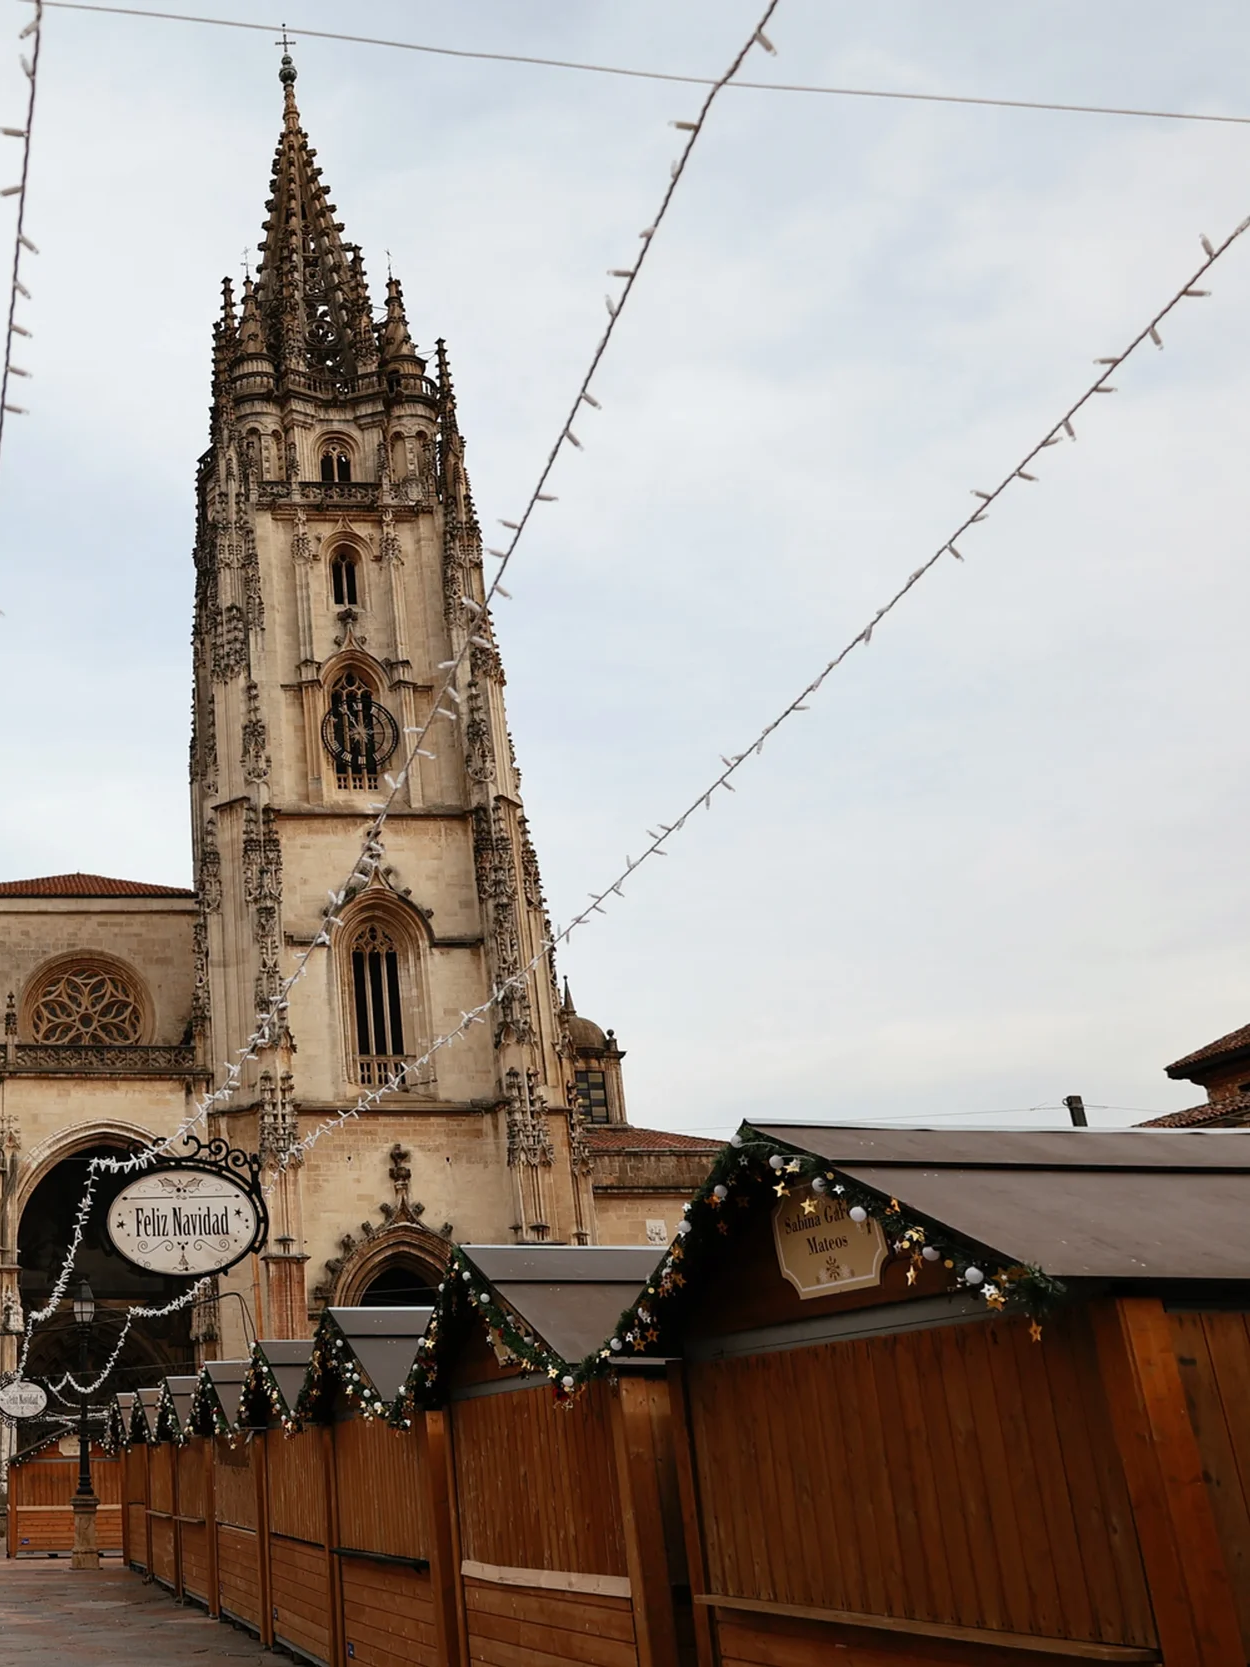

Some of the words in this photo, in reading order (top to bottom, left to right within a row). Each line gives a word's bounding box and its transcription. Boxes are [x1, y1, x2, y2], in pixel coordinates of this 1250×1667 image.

[135, 1207, 168, 1237] Feliz
[172, 1206, 230, 1236] Navidad
[785, 1213, 822, 1235] Sabina
[807, 1235, 848, 1255] Mateos
